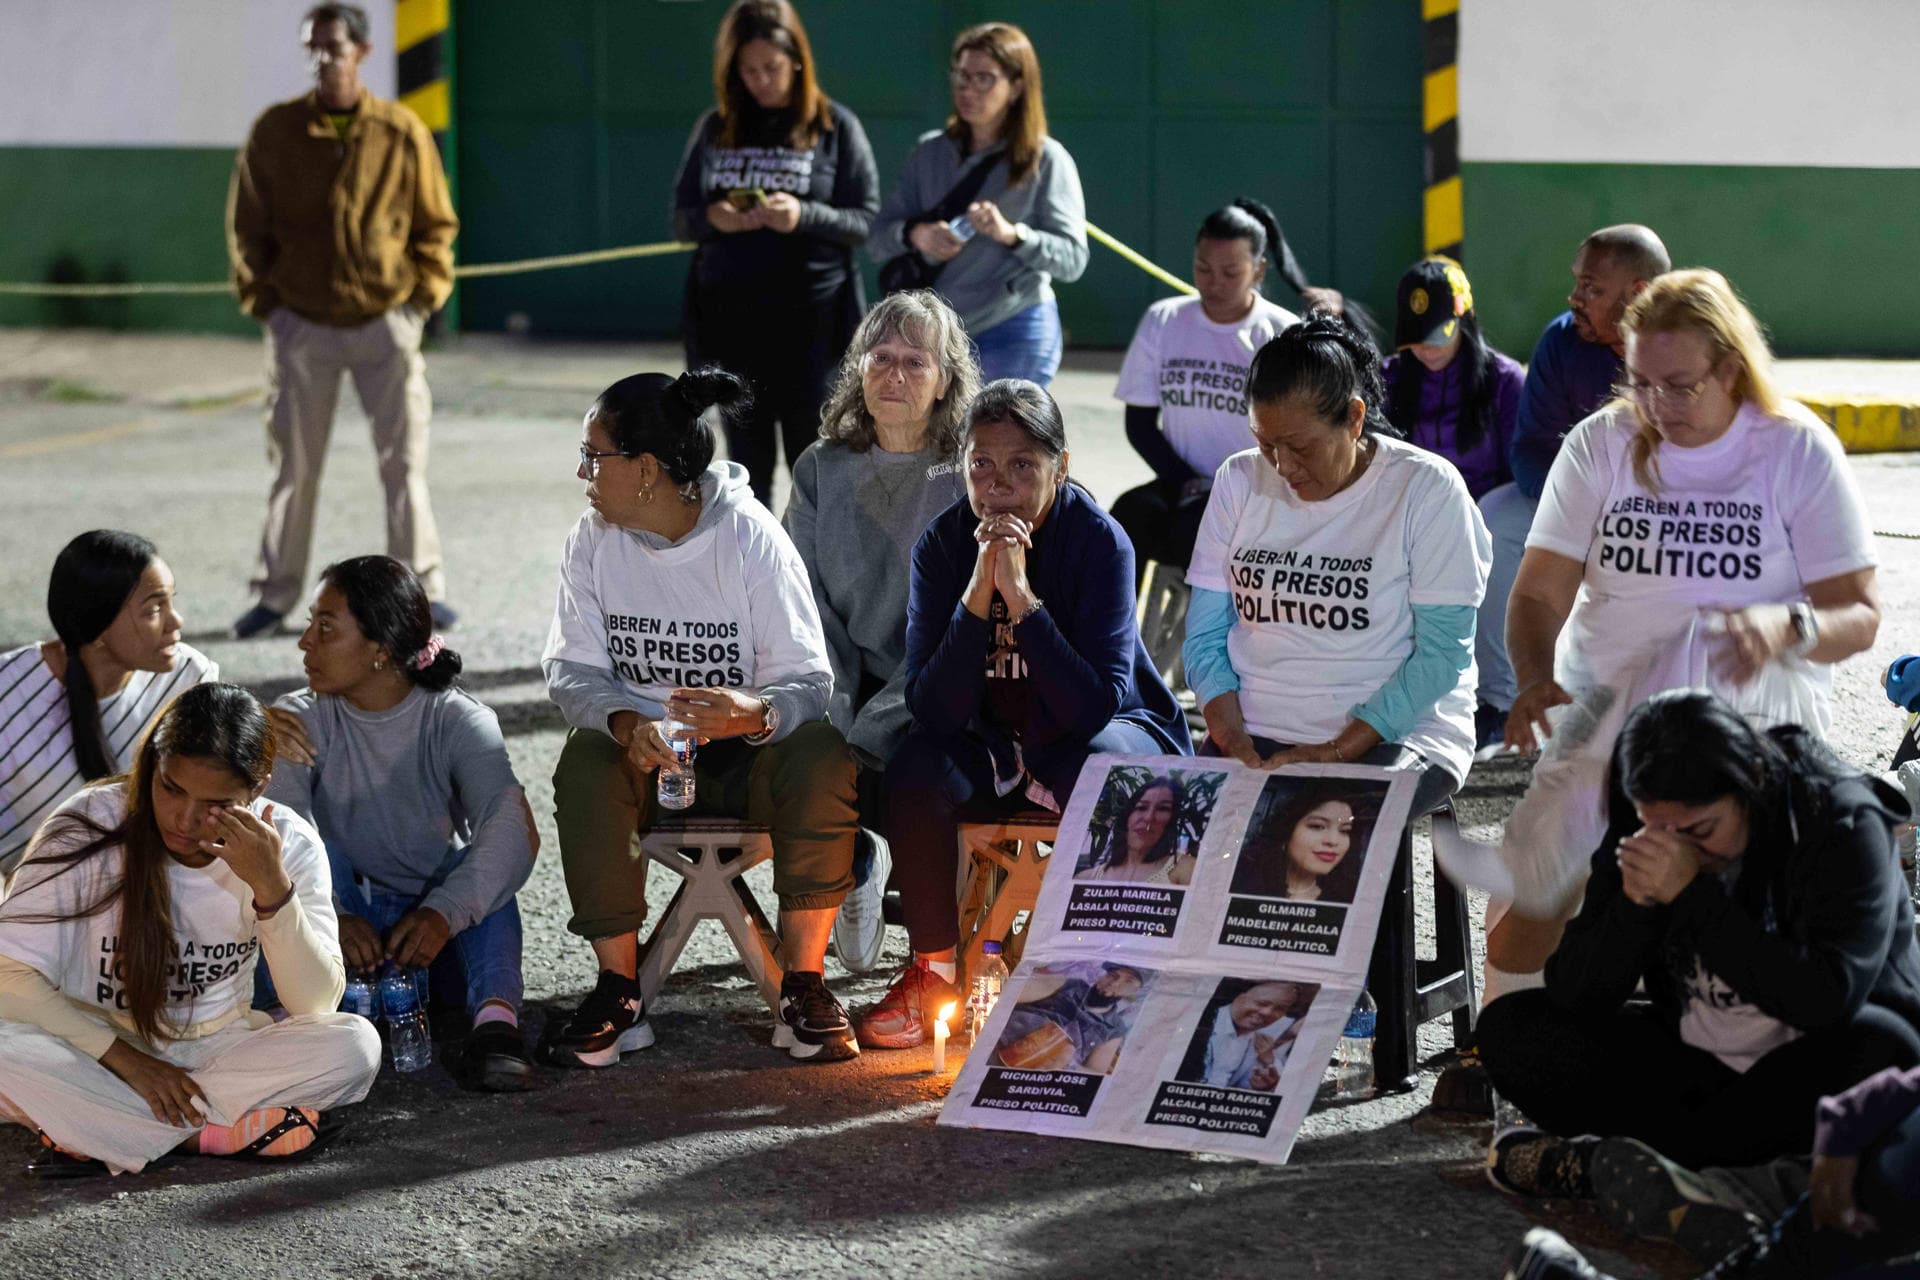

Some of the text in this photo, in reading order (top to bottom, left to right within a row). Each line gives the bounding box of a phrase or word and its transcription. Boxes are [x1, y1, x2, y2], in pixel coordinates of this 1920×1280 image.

[1210, 360, 1217, 370] A
[1221, 361, 1250, 377] TODO
[1160, 370, 1244, 392] LOS PRESO
[1161, 388, 1249, 416] POLÍTICOS
[1610, 497, 1763, 522] LIBEREN A TODOS
[1602, 515, 1761, 548] LOS PRESOS
[1301, 554, 1313, 569] A
[1320, 556, 1373, 573] TODOS
[1600, 543, 1763, 581] POLÍTICOS
[1230, 565, 1370, 600] LOS PRESOS
[1235, 592, 1371, 631] POLÍTICOS
[607, 614, 739, 639] BEREN A TODOS
[607, 635, 740, 665] OS PRESOS
[1083, 888, 1171, 902] ZULMA MARIELA
[1069, 902, 1178, 917] LASALA URGERLLES
[1258, 903, 1317, 918] GILMARIS
[1069, 918, 1106, 927] PRESO
[1226, 916, 1339, 936] MADELEIN ALCALA
[183, 941, 195, 957] A
[202, 936, 257, 960] TODOS
[1226, 934, 1330, 953] PRESO POLITICO.
[1000, 1071, 1088, 1085] RICHARD JOSE
[1160, 1098, 1206, 1111] ALCALA
[1166, 1085, 1272, 1106] GILBERTO RAFAEL
[980, 1098, 1081, 1115] PRESO POLITICO.
[1154, 1112, 1260, 1133] PRESO POLITICO.
